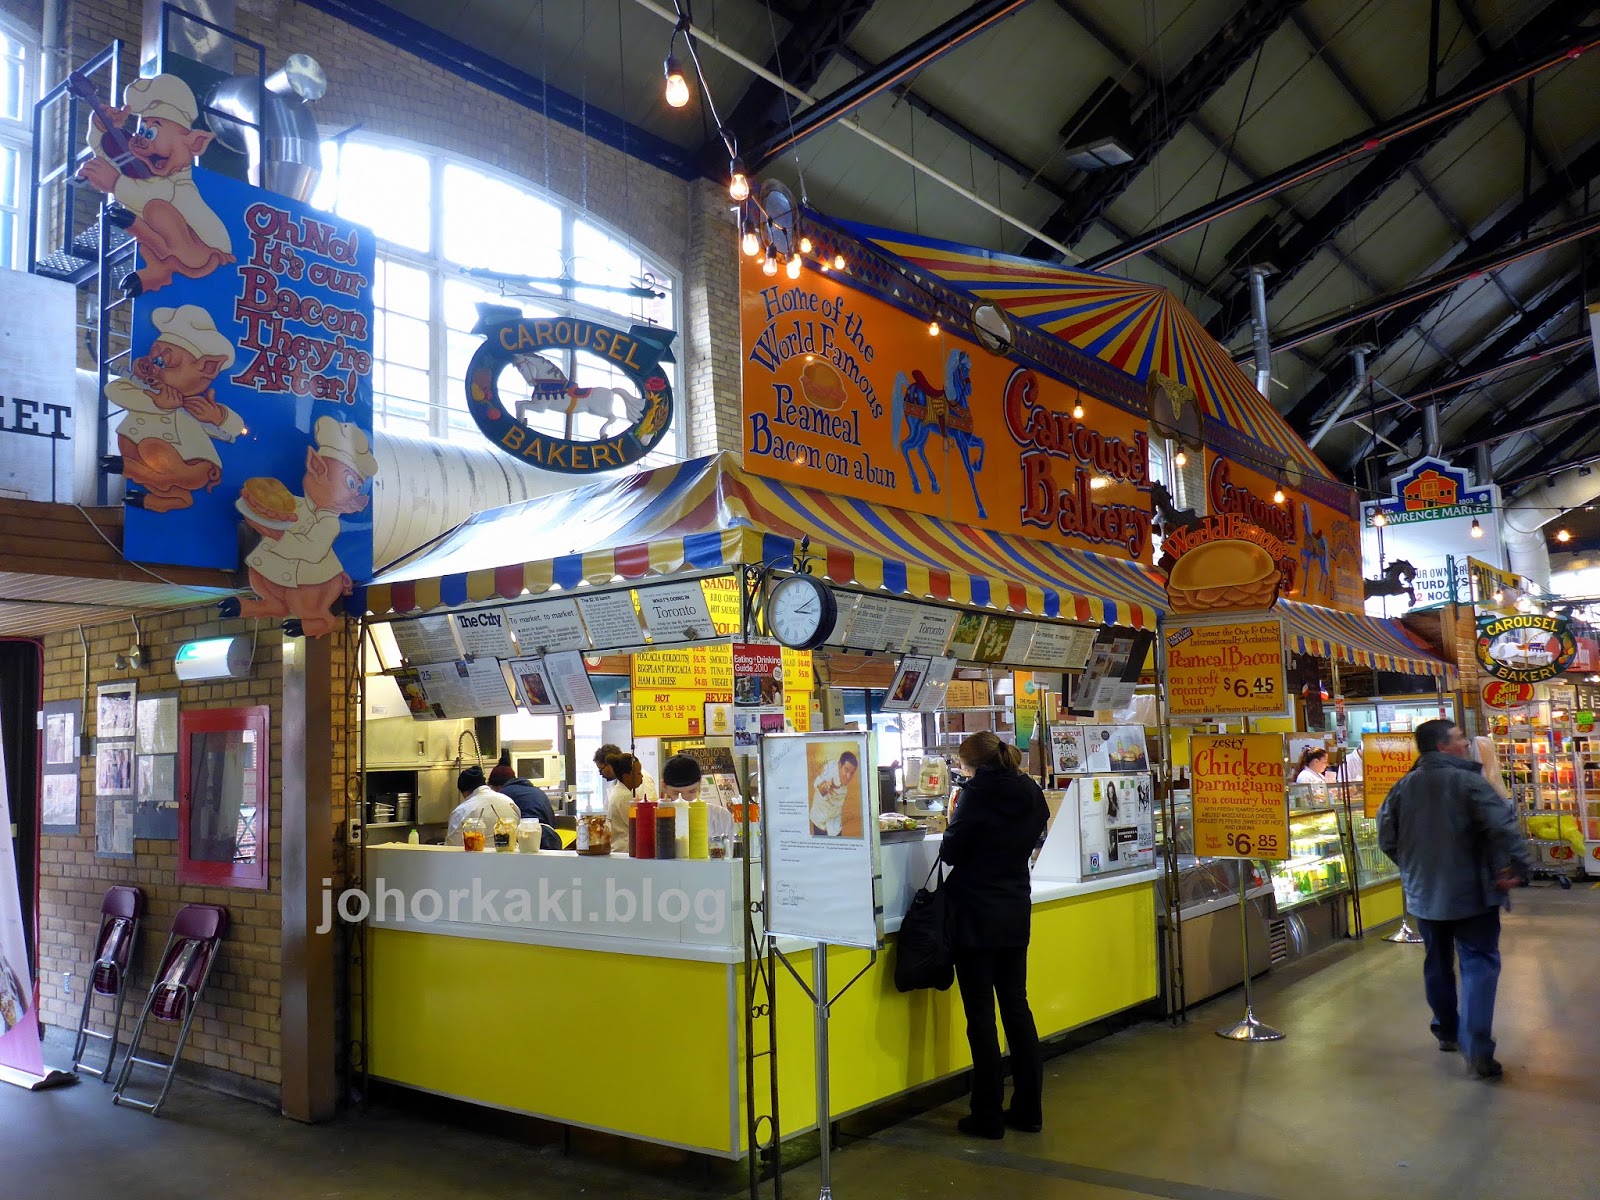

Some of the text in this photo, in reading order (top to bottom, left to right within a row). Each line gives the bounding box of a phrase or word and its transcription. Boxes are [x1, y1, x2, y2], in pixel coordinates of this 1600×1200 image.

[245, 203, 357, 265] Oh No!
[249, 234, 367, 297] It's our
[238, 266, 367, 341] Bacon
[760, 285, 874, 363] Home of the
[234, 306, 371, 374] They're
[500, 321, 641, 371] CAROUSEL
[231, 350, 357, 404] After!
[749, 320, 883, 419] World Famous
[0, 395, 72, 440] ET
[772, 383, 862, 446] Peameal
[1003, 366, 1151, 494] Carousel
[501, 424, 627, 469] BAKERY
[750, 412, 896, 489] Bacon on a bun
[1021, 450, 1152, 558] Bakery
[1458, 497, 1475, 506] 1803
[1380, 509, 1439, 524] AWRENCE
[1162, 512, 1290, 560] World Famous
[457, 612, 502, 628] The City
[508, 617, 518, 625] To
[543, 613, 551, 621] to
[653, 605, 697, 619] Toronto
[919, 621, 945, 636] Toronto
[1196, 627, 1221, 638] Savour
[1222, 626, 1234, 637] the
[1234, 627, 1250, 636] One
[1259, 626, 1280, 635] Only
[1486, 616, 1559, 637] CAROUSEL
[1190, 635, 1242, 647] Internationally
[1242, 634, 1280, 644] Acclaimed
[636, 652, 661, 662] FOCCACIA
[662, 653, 690, 664] (COLDCUTS)
[709, 656, 729, 664] SMOKED
[1168, 645, 1280, 668] Peameal Bacon
[420, 670, 431, 680] 25
[514, 665, 543, 674] SAVEUR
[637, 664, 666, 674] EGGPLANT
[666, 665, 692, 674] FOCCACIA
[710, 667, 724, 675] TUNA
[735, 663, 768, 673] Guide 2010
[902, 662, 927, 672] SAVEUR
[1496, 664, 1558, 682] BAKERY
[637, 677, 651, 685] HAM
[651, 677, 656, 685] &
[657, 677, 677, 686] CHEESE
[711, 678, 729, 686] VEGGIE
[1187, 676, 1194, 684] a
[1197, 669, 1220, 684] soft
[1171, 685, 1216, 698] country
[1223, 677, 1274, 698] $6.45
[1498, 681, 1521, 695] Jelly
[655, 694, 671, 702] HOT
[1182, 695, 1205, 706] bun
[1491, 693, 1518, 705] Belly
[1169, 706, 1202, 714] Experience
[1203, 705, 1216, 714] this
[1216, 704, 1241, 714] Toronto
[1211, 737, 1245, 750] zesty
[1375, 742, 1413, 762] Veal
[1194, 748, 1284, 777] Chicken
[1194, 777, 1284, 795] parmigiana
[1220, 796, 1259, 807] country
[1261, 793, 1281, 806] bun
[1226, 832, 1278, 856] $6.85
